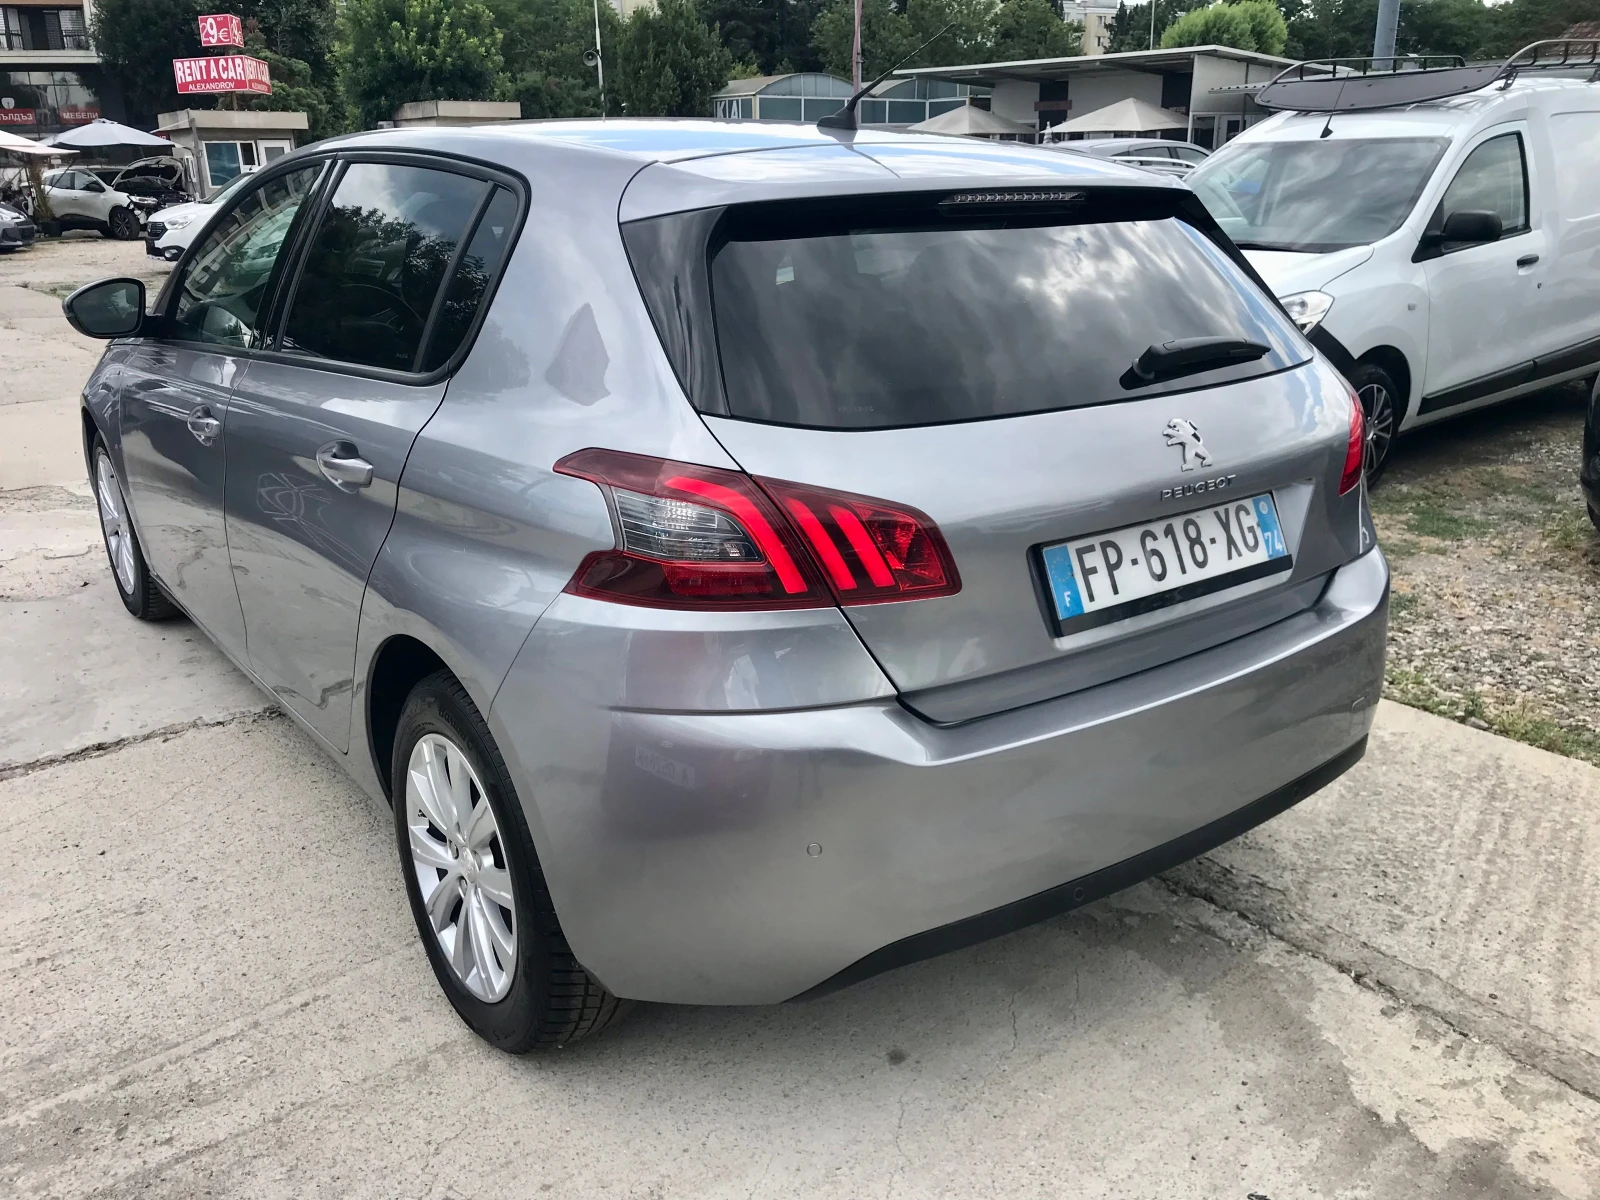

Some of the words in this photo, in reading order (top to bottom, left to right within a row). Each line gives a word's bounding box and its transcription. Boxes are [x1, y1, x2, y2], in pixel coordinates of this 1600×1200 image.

[175, 60, 207, 84] RENT
[210, 58, 218, 79] A
[219, 57, 246, 80] CAR
[188, 81, 235, 91] ALEXANDROV
[63, 111, 99, 120] МЕБЕЛИ
[1160, 474, 1236, 501] PEUGEOT
[1063, 591, 1072, 607] F
[1074, 503, 1259, 603] FP-618-XG
[1263, 531, 1285, 555] 74
